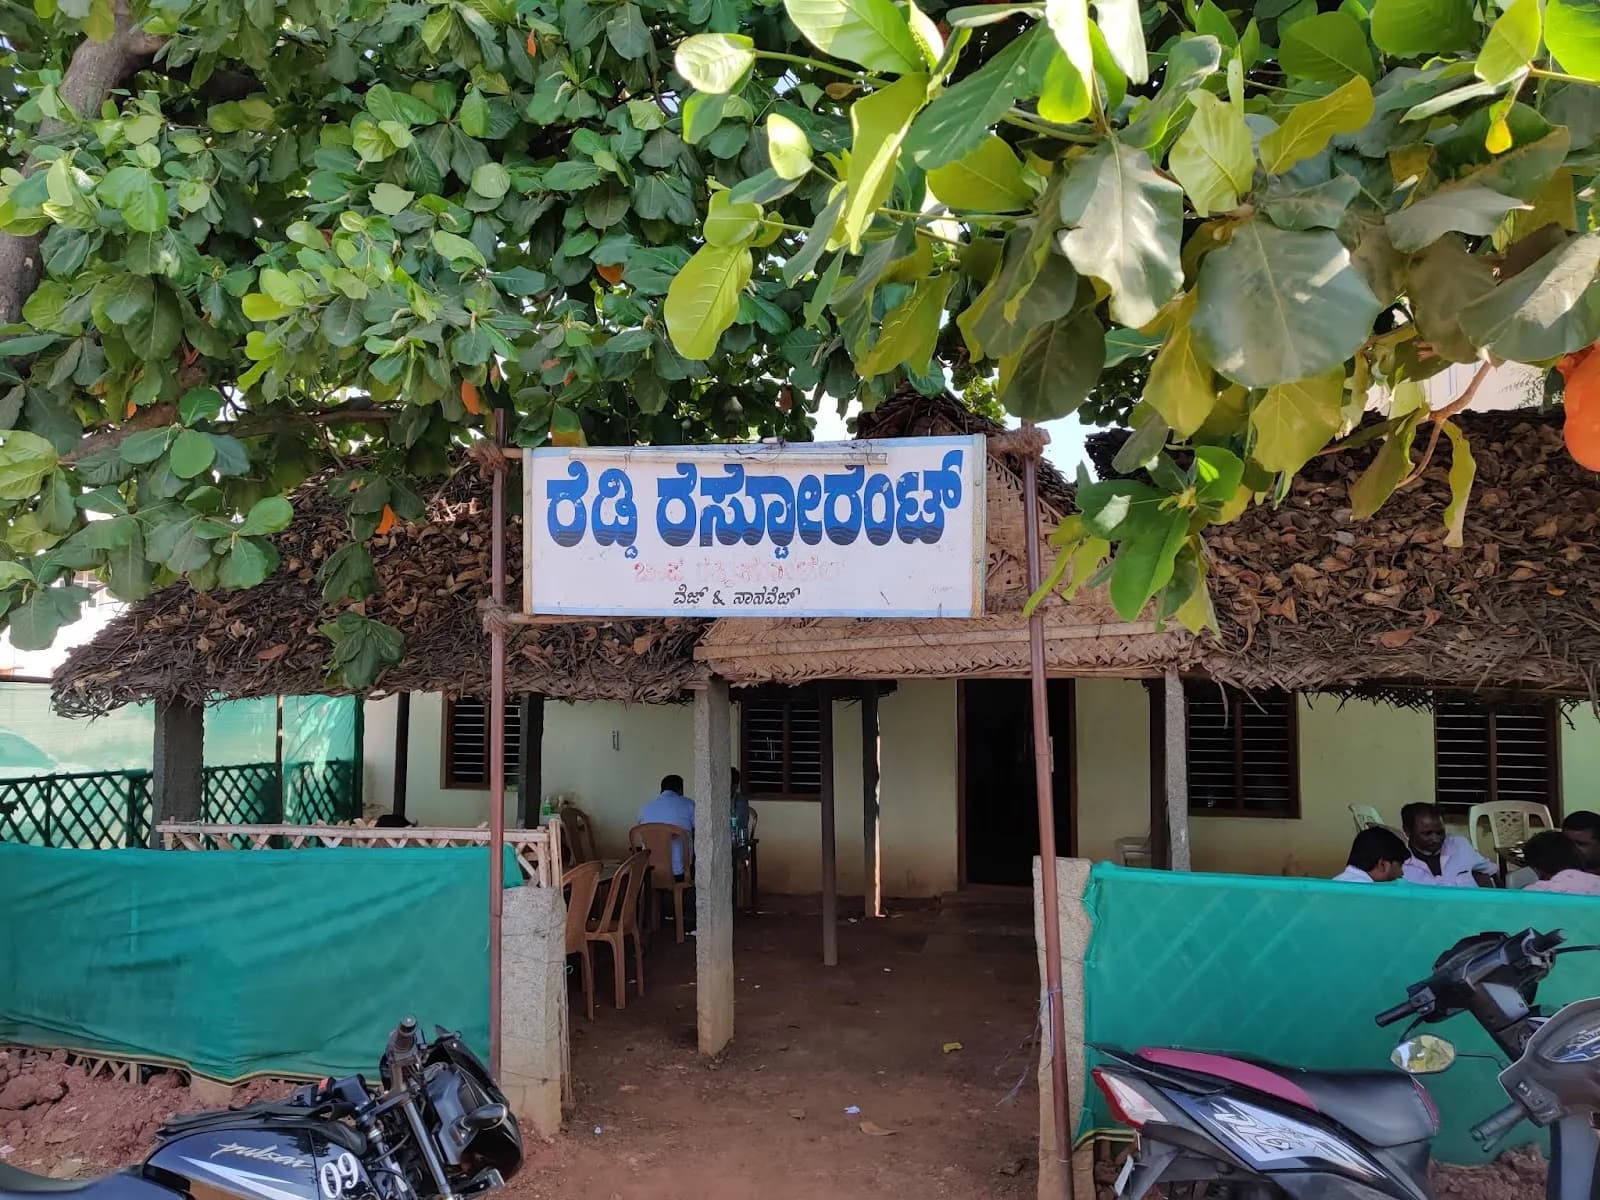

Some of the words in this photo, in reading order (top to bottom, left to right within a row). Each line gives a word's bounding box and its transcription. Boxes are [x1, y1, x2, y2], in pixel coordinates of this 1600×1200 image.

[547, 460, 638, 559] ರೆಡ್ಡಿ
[673, 583, 709, 605] ವೆಜ್
[712, 589, 726, 606] &
[320, 1152, 359, 1199] 09
